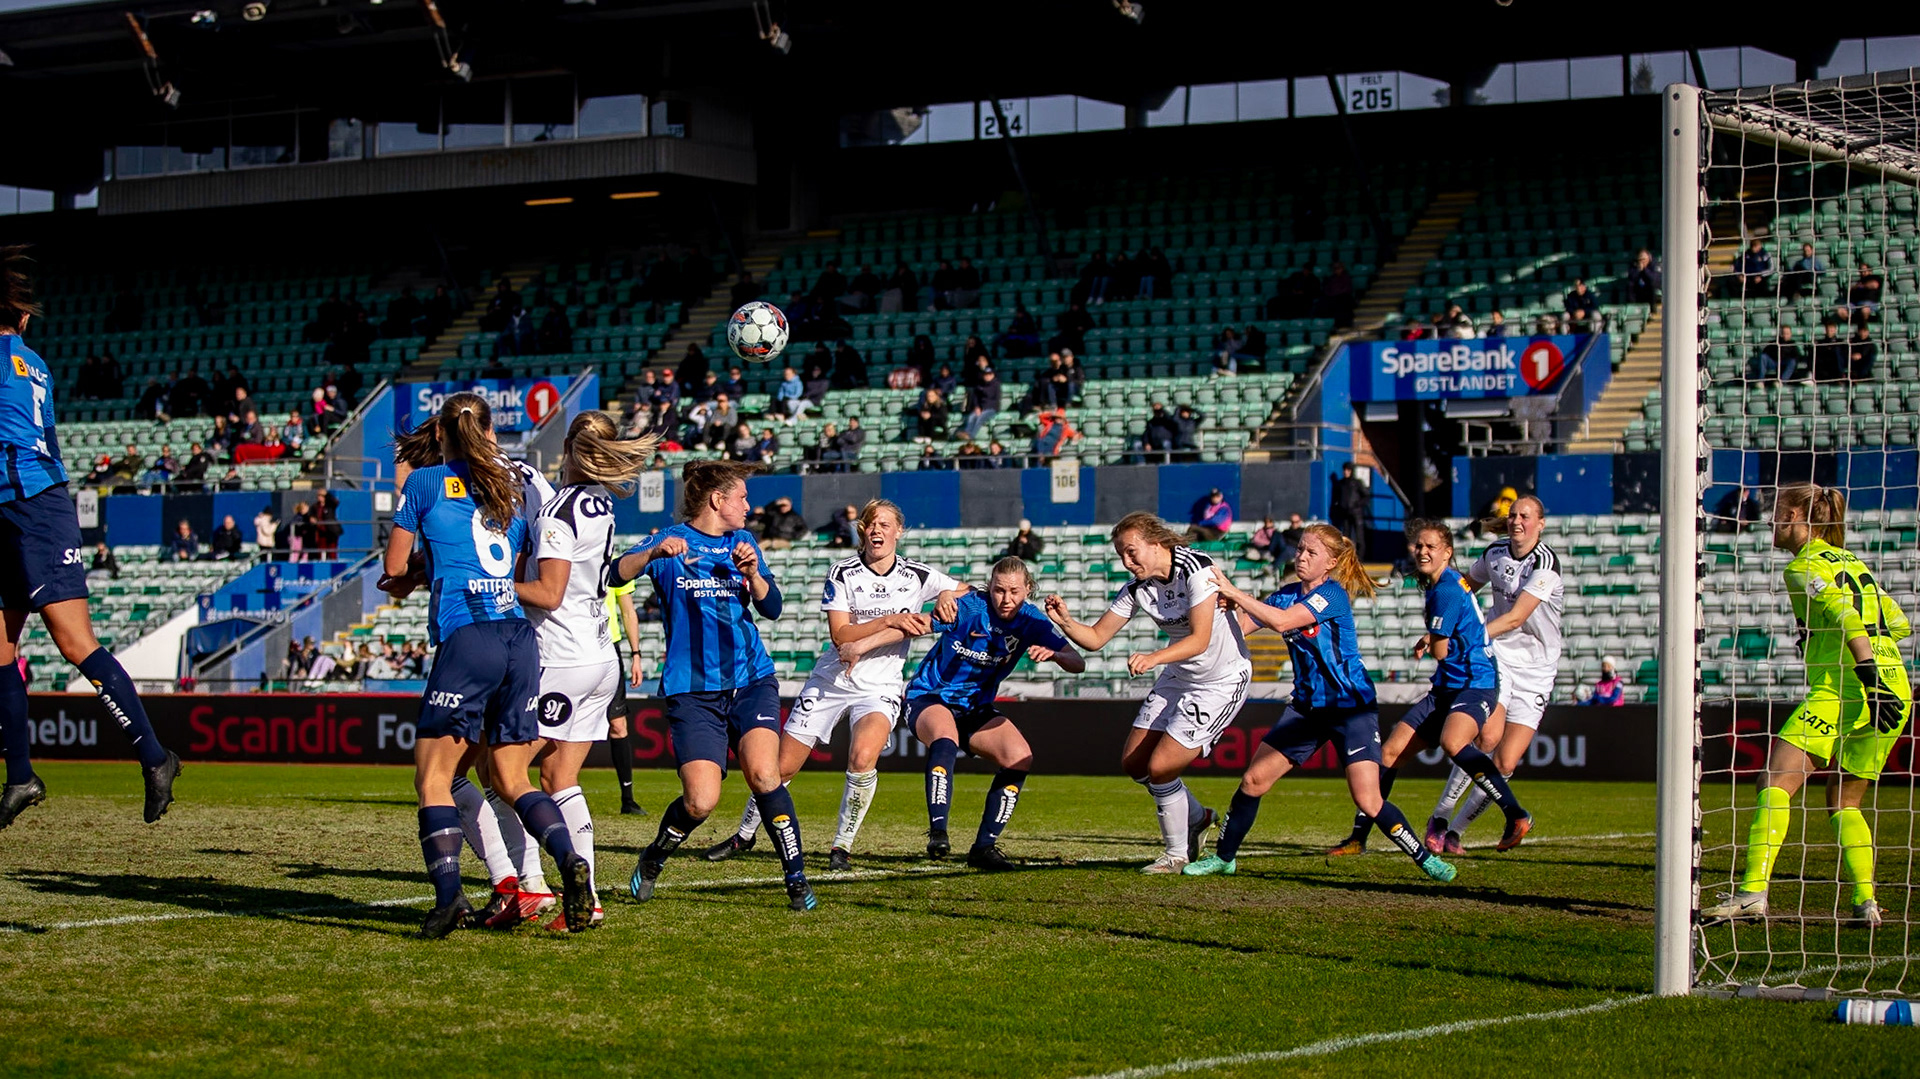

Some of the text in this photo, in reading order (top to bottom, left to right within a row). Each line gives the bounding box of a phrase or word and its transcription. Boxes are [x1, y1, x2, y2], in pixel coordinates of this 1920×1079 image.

[1361, 75, 1383, 85] FELT
[1352, 87, 1392, 110] 205
[984, 115, 1022, 136] 24
[1380, 343, 1550, 382] SpareBank 1
[1415, 374, 1517, 393] ØSTLANDET
[1055, 474, 1077, 489] 106
[471, 504, 513, 578] 6
[62, 548, 83, 566] SA
[676, 576, 741, 591] SpareBank
[869, 592, 892, 600] OBOS
[849, 605, 898, 617] SpareBank
[428, 690, 464, 710] SATS
[524, 695, 540, 713] SA
[800, 719, 809, 728] 14
[1142, 712, 1151, 722] 10
[1798, 710, 1834, 735] SATS
[188, 703, 364, 756] Scandic
[845, 790, 861, 833] RAMIRENT
[782, 826, 800, 861] ARKEL
